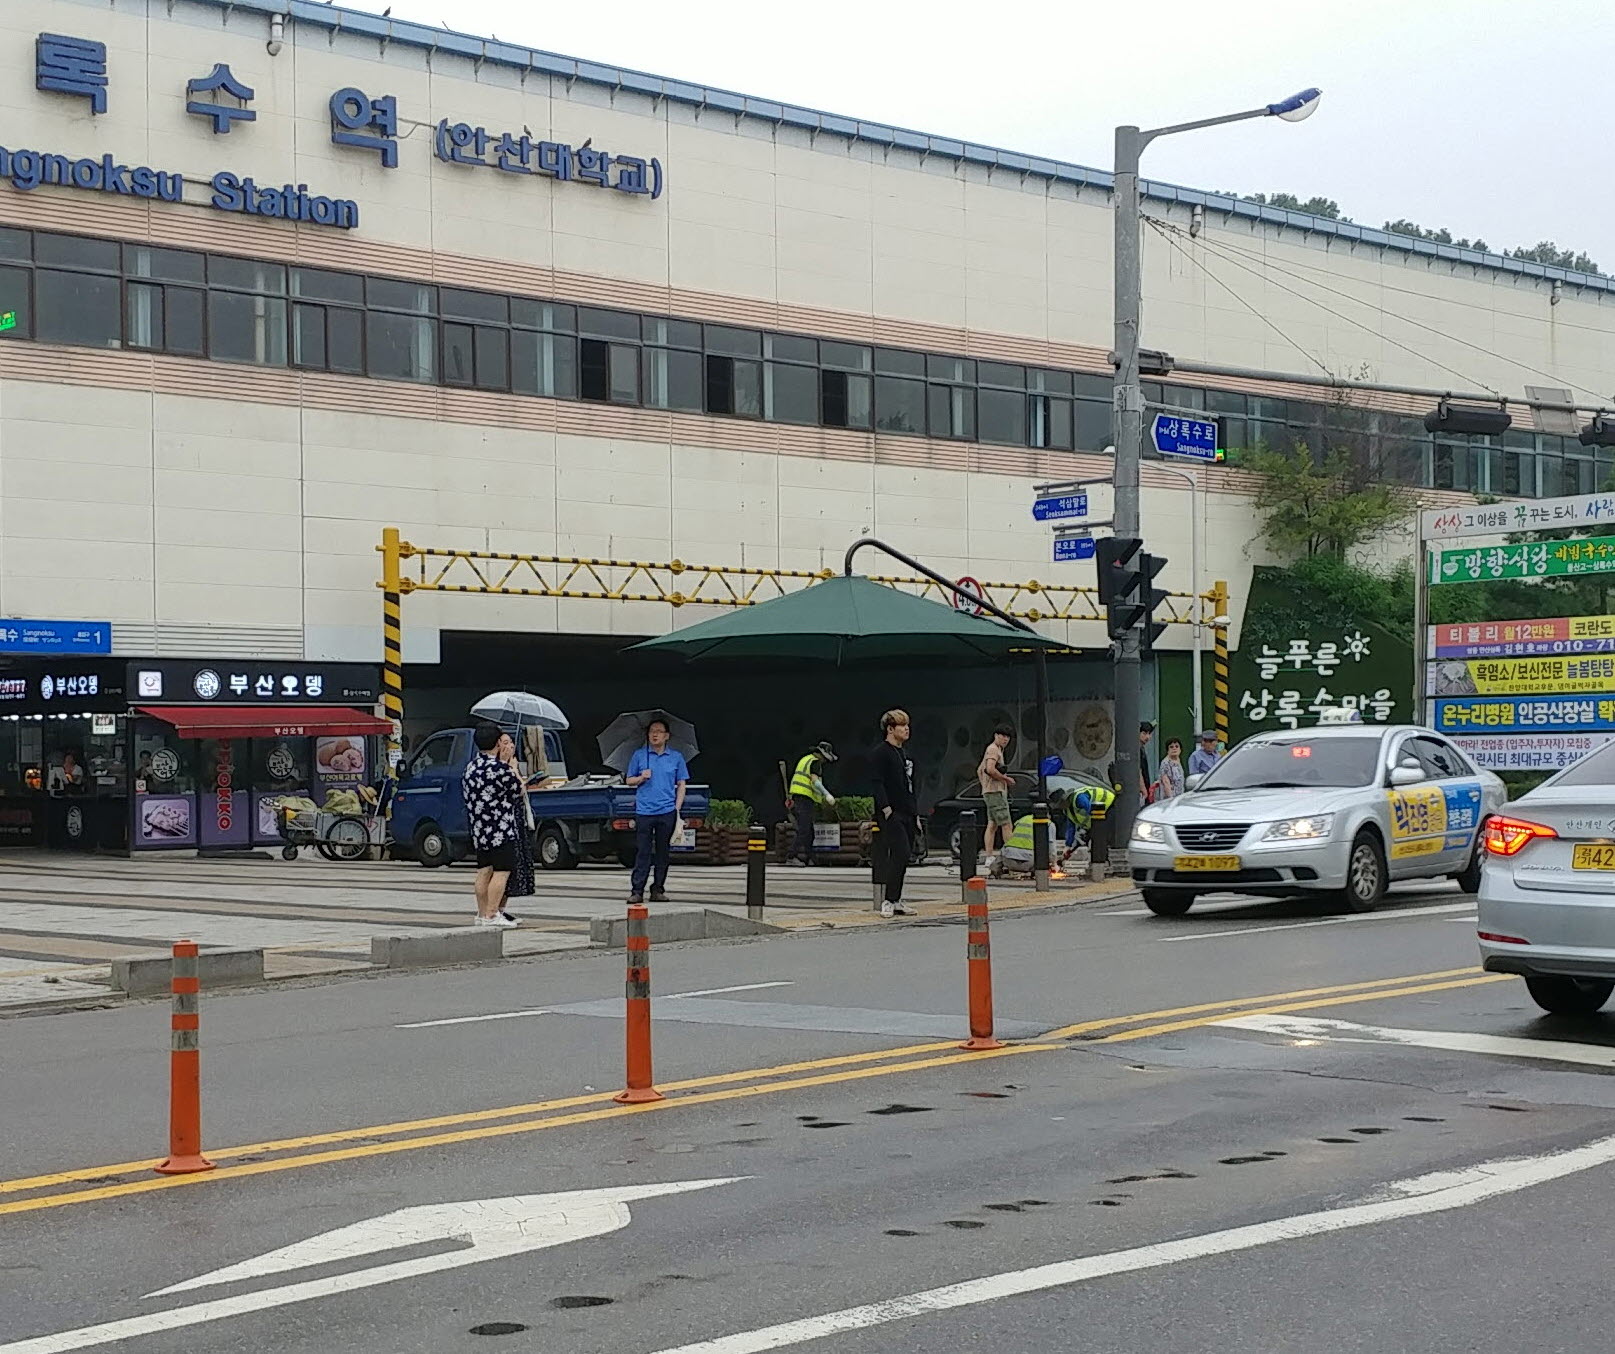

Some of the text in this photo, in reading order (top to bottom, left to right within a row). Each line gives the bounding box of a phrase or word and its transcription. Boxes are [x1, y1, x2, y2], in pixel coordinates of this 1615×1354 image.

[434, 117, 663, 200] (안산대학교)
[211, 171, 359, 229] Station
[1169, 419, 1214, 441] 상록수로
[93, 630, 101, 645] 1
[1573, 619, 1613, 637] 코란도
[1255, 639, 1341, 680] 늘푸른
[1476, 661, 1563, 682] 흑염소/보신전문
[56, 674, 98, 696] 부산오뎅
[229, 673, 323, 697] 부산오뎅
[1442, 703, 1515, 726] 온누리병원
[1518, 700, 1595, 725] 인공신장실
[1566, 737, 1592, 749] 모집중
[1510, 752, 1553, 767] 최대규모
